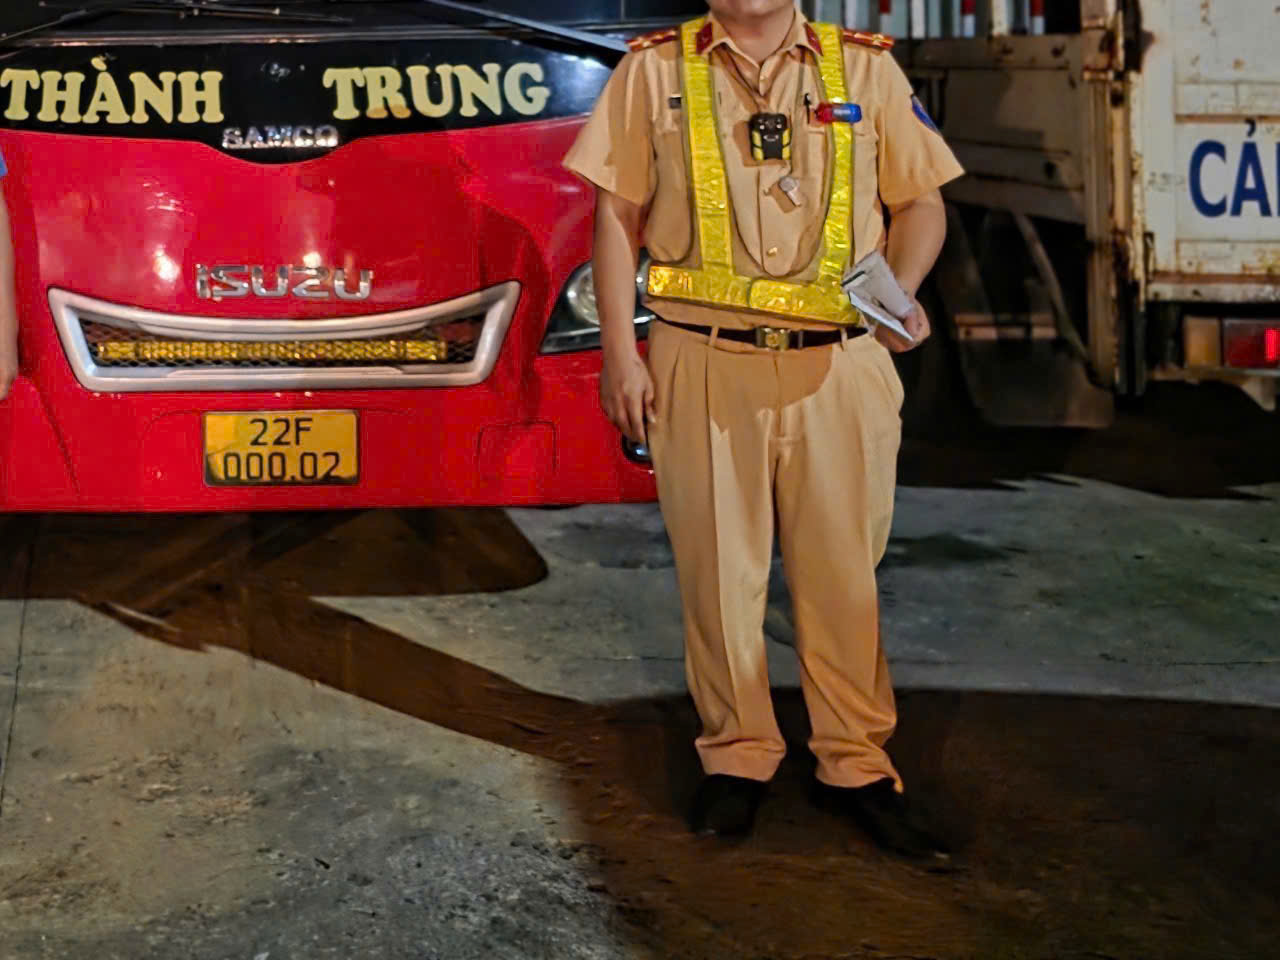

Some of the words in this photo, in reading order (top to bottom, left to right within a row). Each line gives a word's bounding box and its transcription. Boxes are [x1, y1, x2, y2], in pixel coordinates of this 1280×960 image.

[0, 56, 225, 124] THÀNH
[322, 62, 552, 121] TRUNG
[221, 124, 339, 149] SAMCO
[1188, 117, 1280, 219] CẢ
[196, 264, 375, 301] ISUZU
[249, 417, 313, 446] 22F
[223, 452, 341, 481] 000.02
